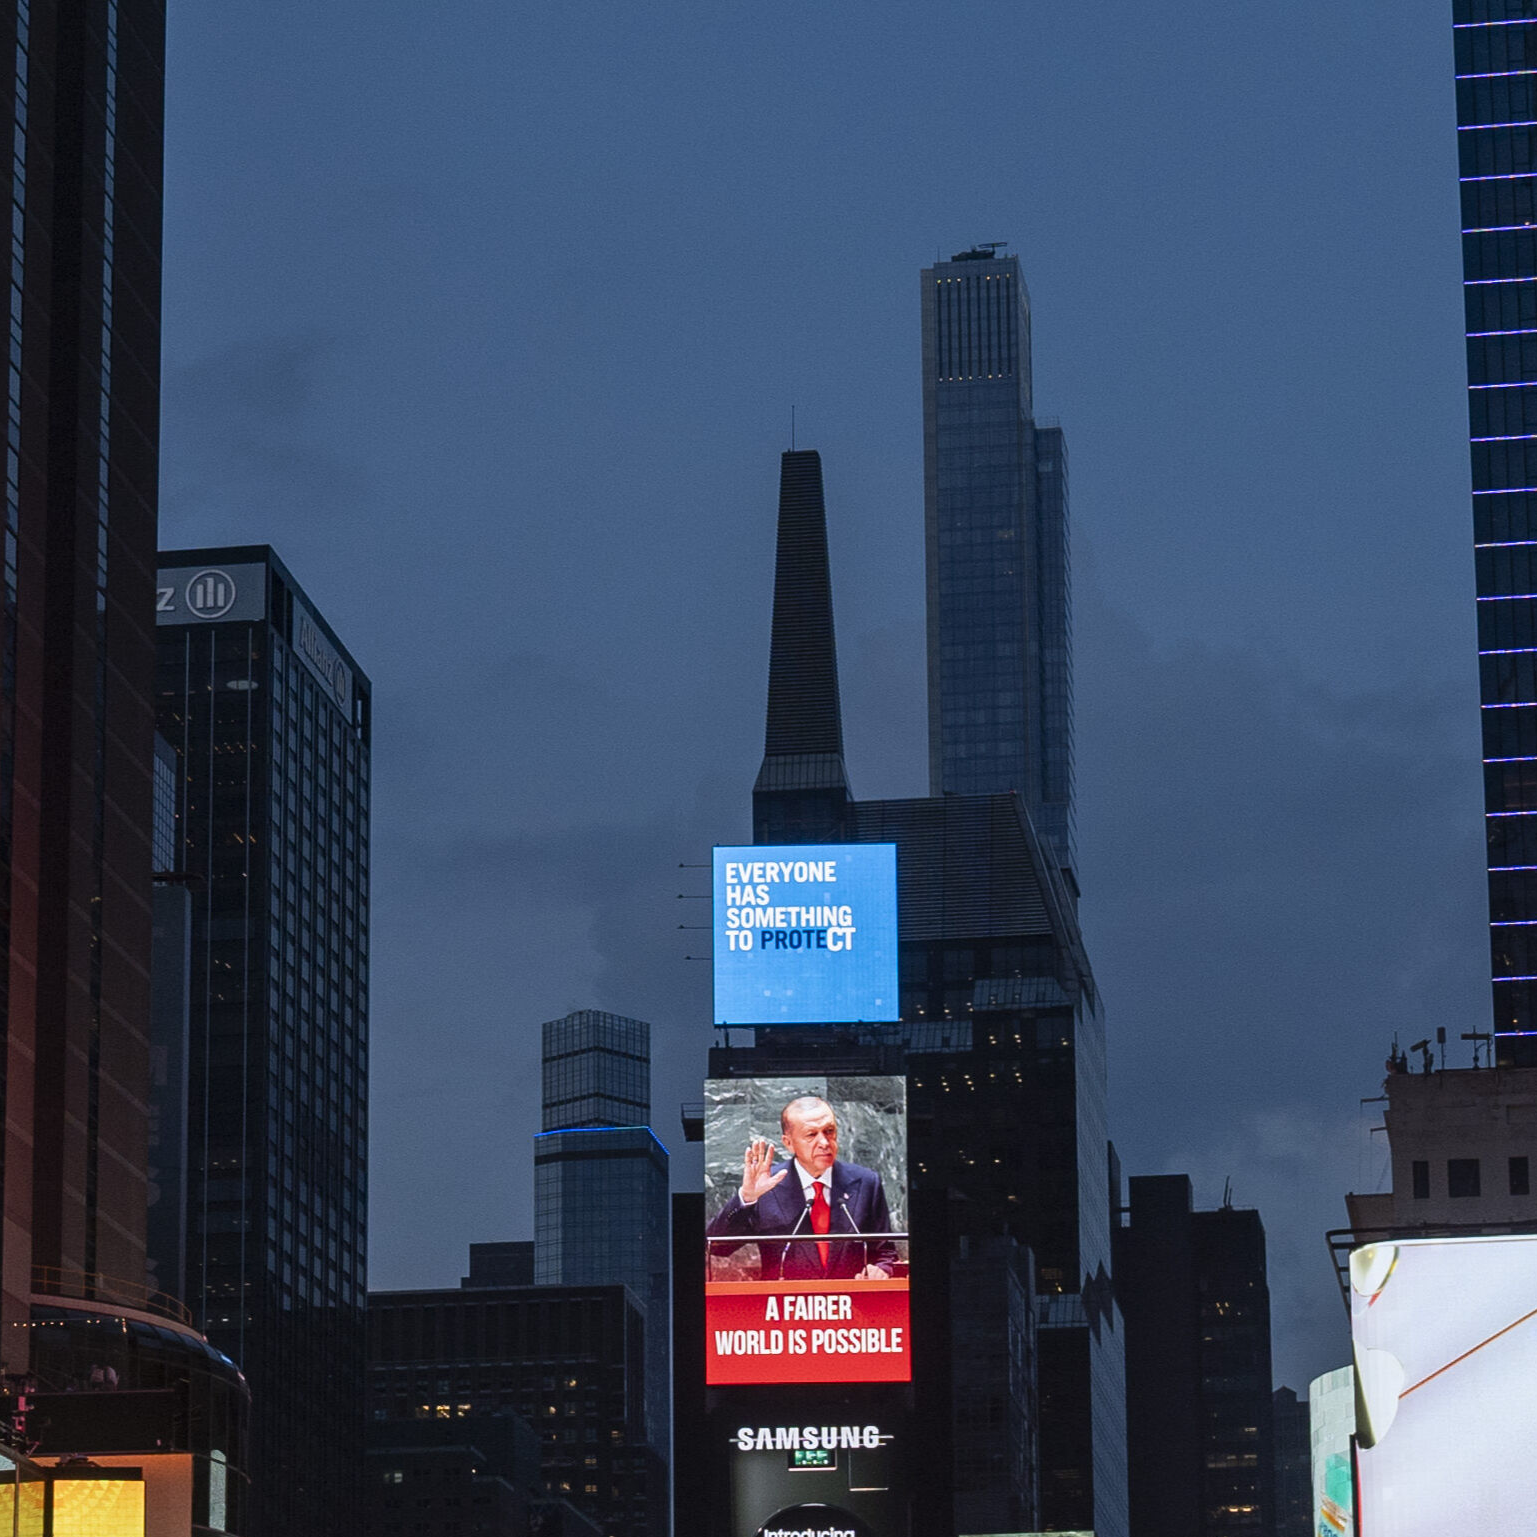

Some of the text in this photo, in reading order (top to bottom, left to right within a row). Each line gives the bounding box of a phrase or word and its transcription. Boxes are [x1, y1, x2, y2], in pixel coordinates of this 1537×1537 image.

[726, 861, 837, 883] EVERYONE
[726, 884, 770, 906] HAS
[726, 905, 853, 928] SOMETHING
[725, 927, 857, 951] TO PROTECT
[765, 1295, 852, 1321] A FAIRER
[715, 1327, 903, 1355] WORLD IS POSSIBLE
[737, 1426, 880, 1450] SAMSUNG
